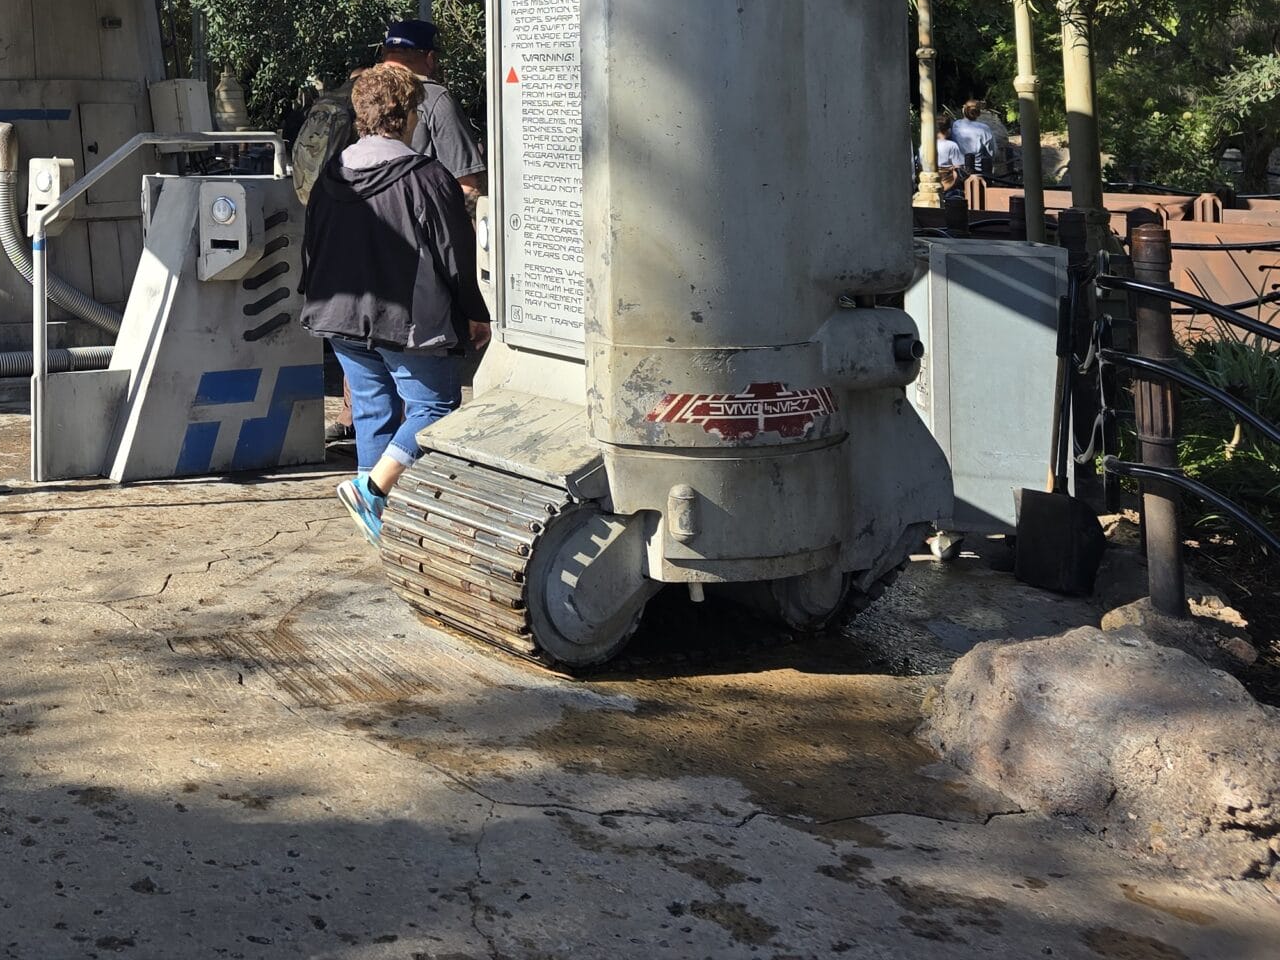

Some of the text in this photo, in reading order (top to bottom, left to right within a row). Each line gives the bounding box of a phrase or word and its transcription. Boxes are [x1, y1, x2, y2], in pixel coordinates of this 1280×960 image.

[522, 54, 574, 62] WARNING!
[523, 152, 581, 160] AGGRAVATED
[523, 174, 571, 183] EXPECTANT
[523, 183, 557, 191] SHOULD
[524, 197, 567, 207] SUPERVISE
[524, 215, 563, 224] CHILDREN
[524, 223, 541, 231] AGE
[551, 226, 578, 235] YEARS
[533, 242, 566, 251] PERSON
[533, 250, 560, 259] YEARS
[525, 264, 562, 275] PERSONS
[544, 275, 565, 283] MEET
[525, 281, 561, 292] MINIMUM
[525, 290, 582, 304] REQUIREMENT
[525, 298, 542, 306] MAY
[544, 301, 561, 309] NOT
[526, 313, 547, 321] MUST
